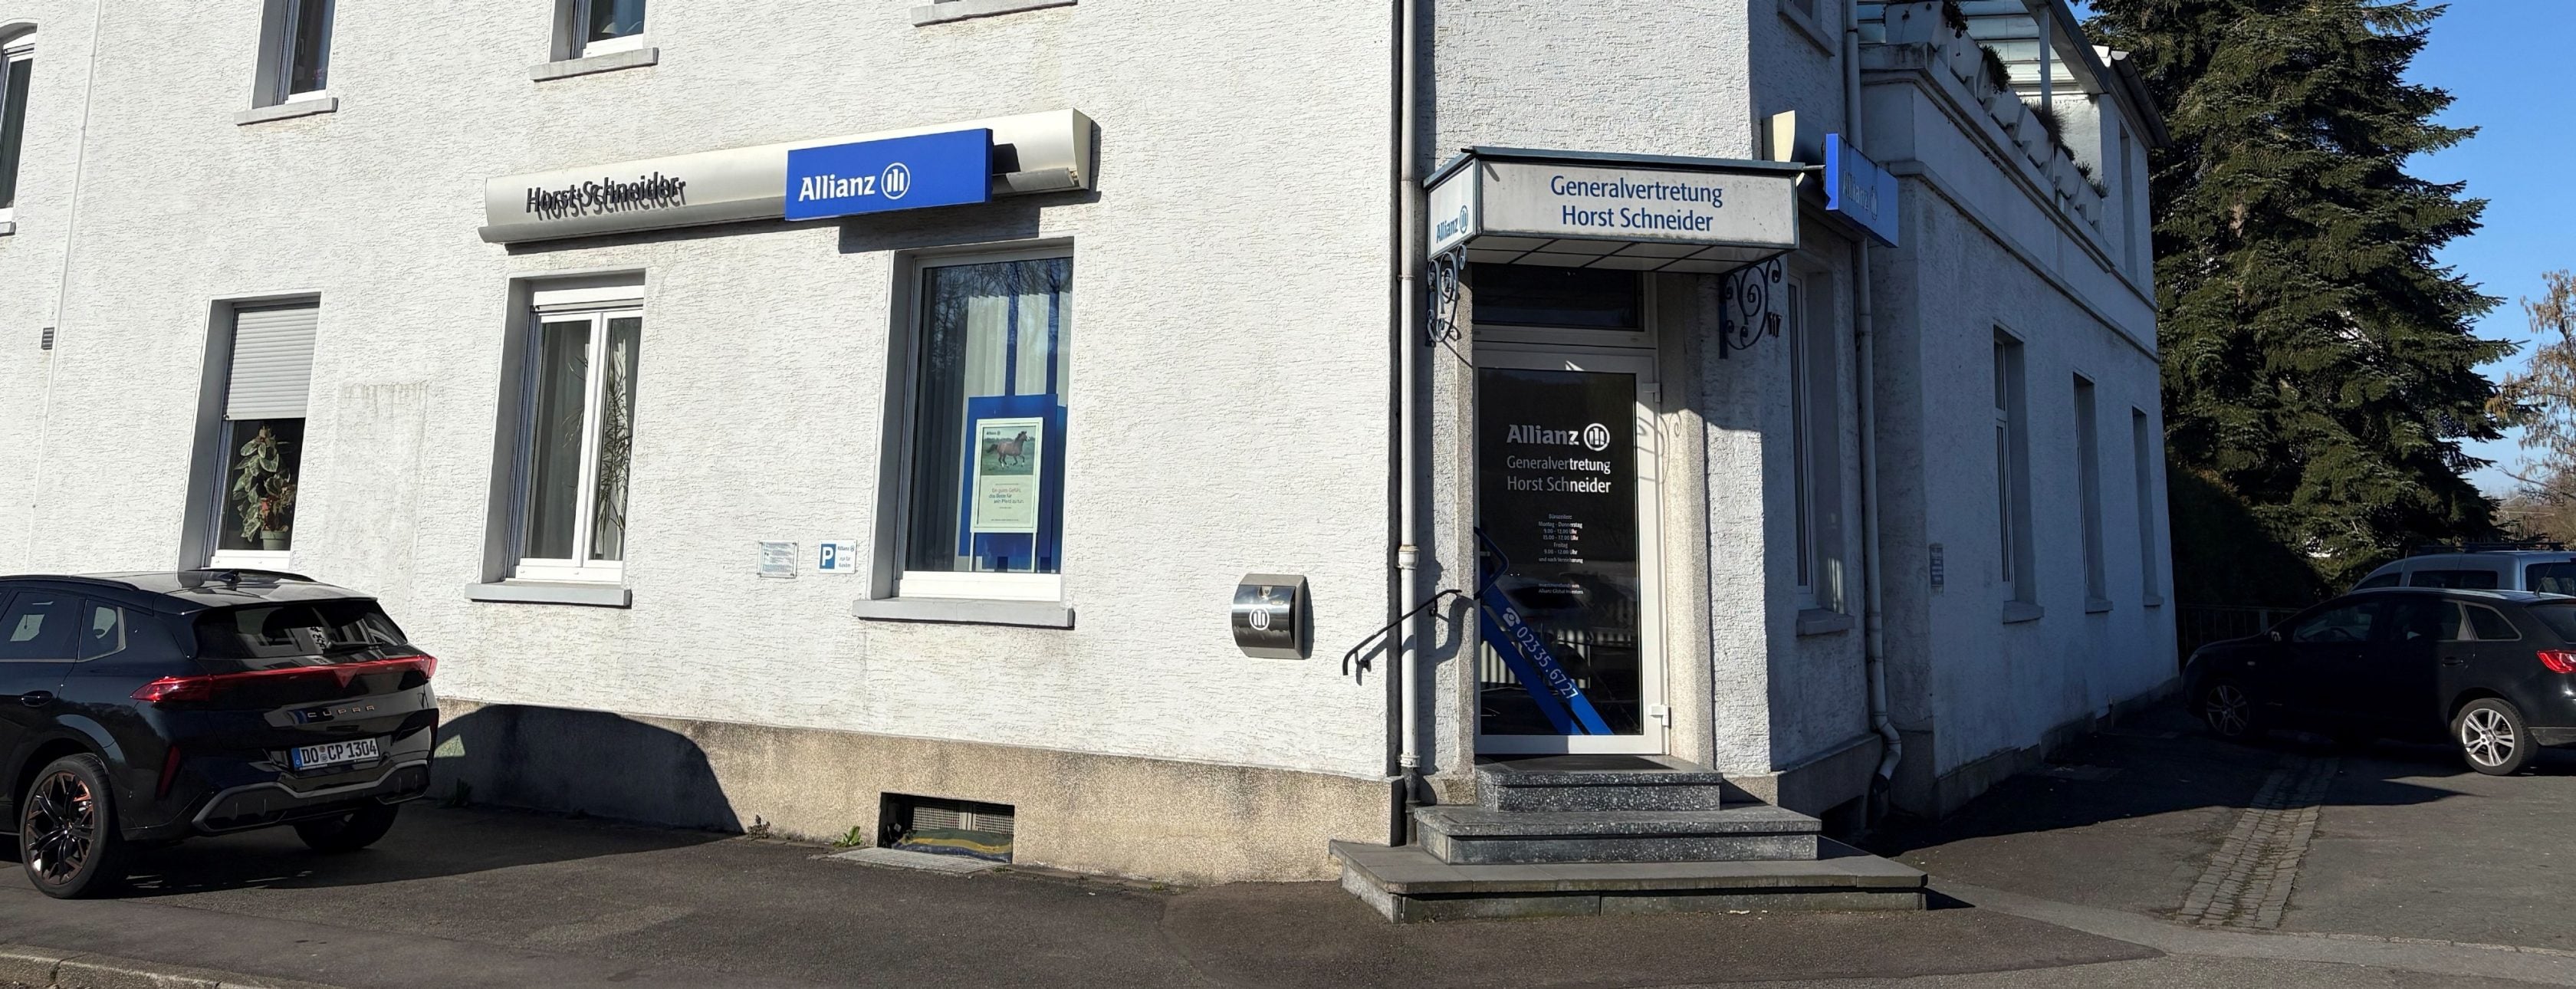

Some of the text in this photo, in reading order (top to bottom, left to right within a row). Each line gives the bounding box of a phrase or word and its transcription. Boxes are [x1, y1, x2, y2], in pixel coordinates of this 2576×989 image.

[526, 171, 680, 213] Horst Schneider
[798, 174, 876, 202] Allianz
[1550, 175, 1723, 209] Generalvertretung
[1842, 170, 1869, 211] Allianz
[1436, 217, 1458, 244] Allianz
[1562, 205, 1714, 231] Horst Schneider
[1506, 424, 1579, 445] Allianz
[1506, 455, 1611, 475] Generalvertretung
[1507, 475, 1612, 493] Horst Schneider
[1516, 626, 1579, 698] 02335.6727
[307, 705, 375, 718] CUPRA
[301, 748, 319, 764] DO
[327, 744, 343, 761] CP
[347, 740, 377, 758] 1304
